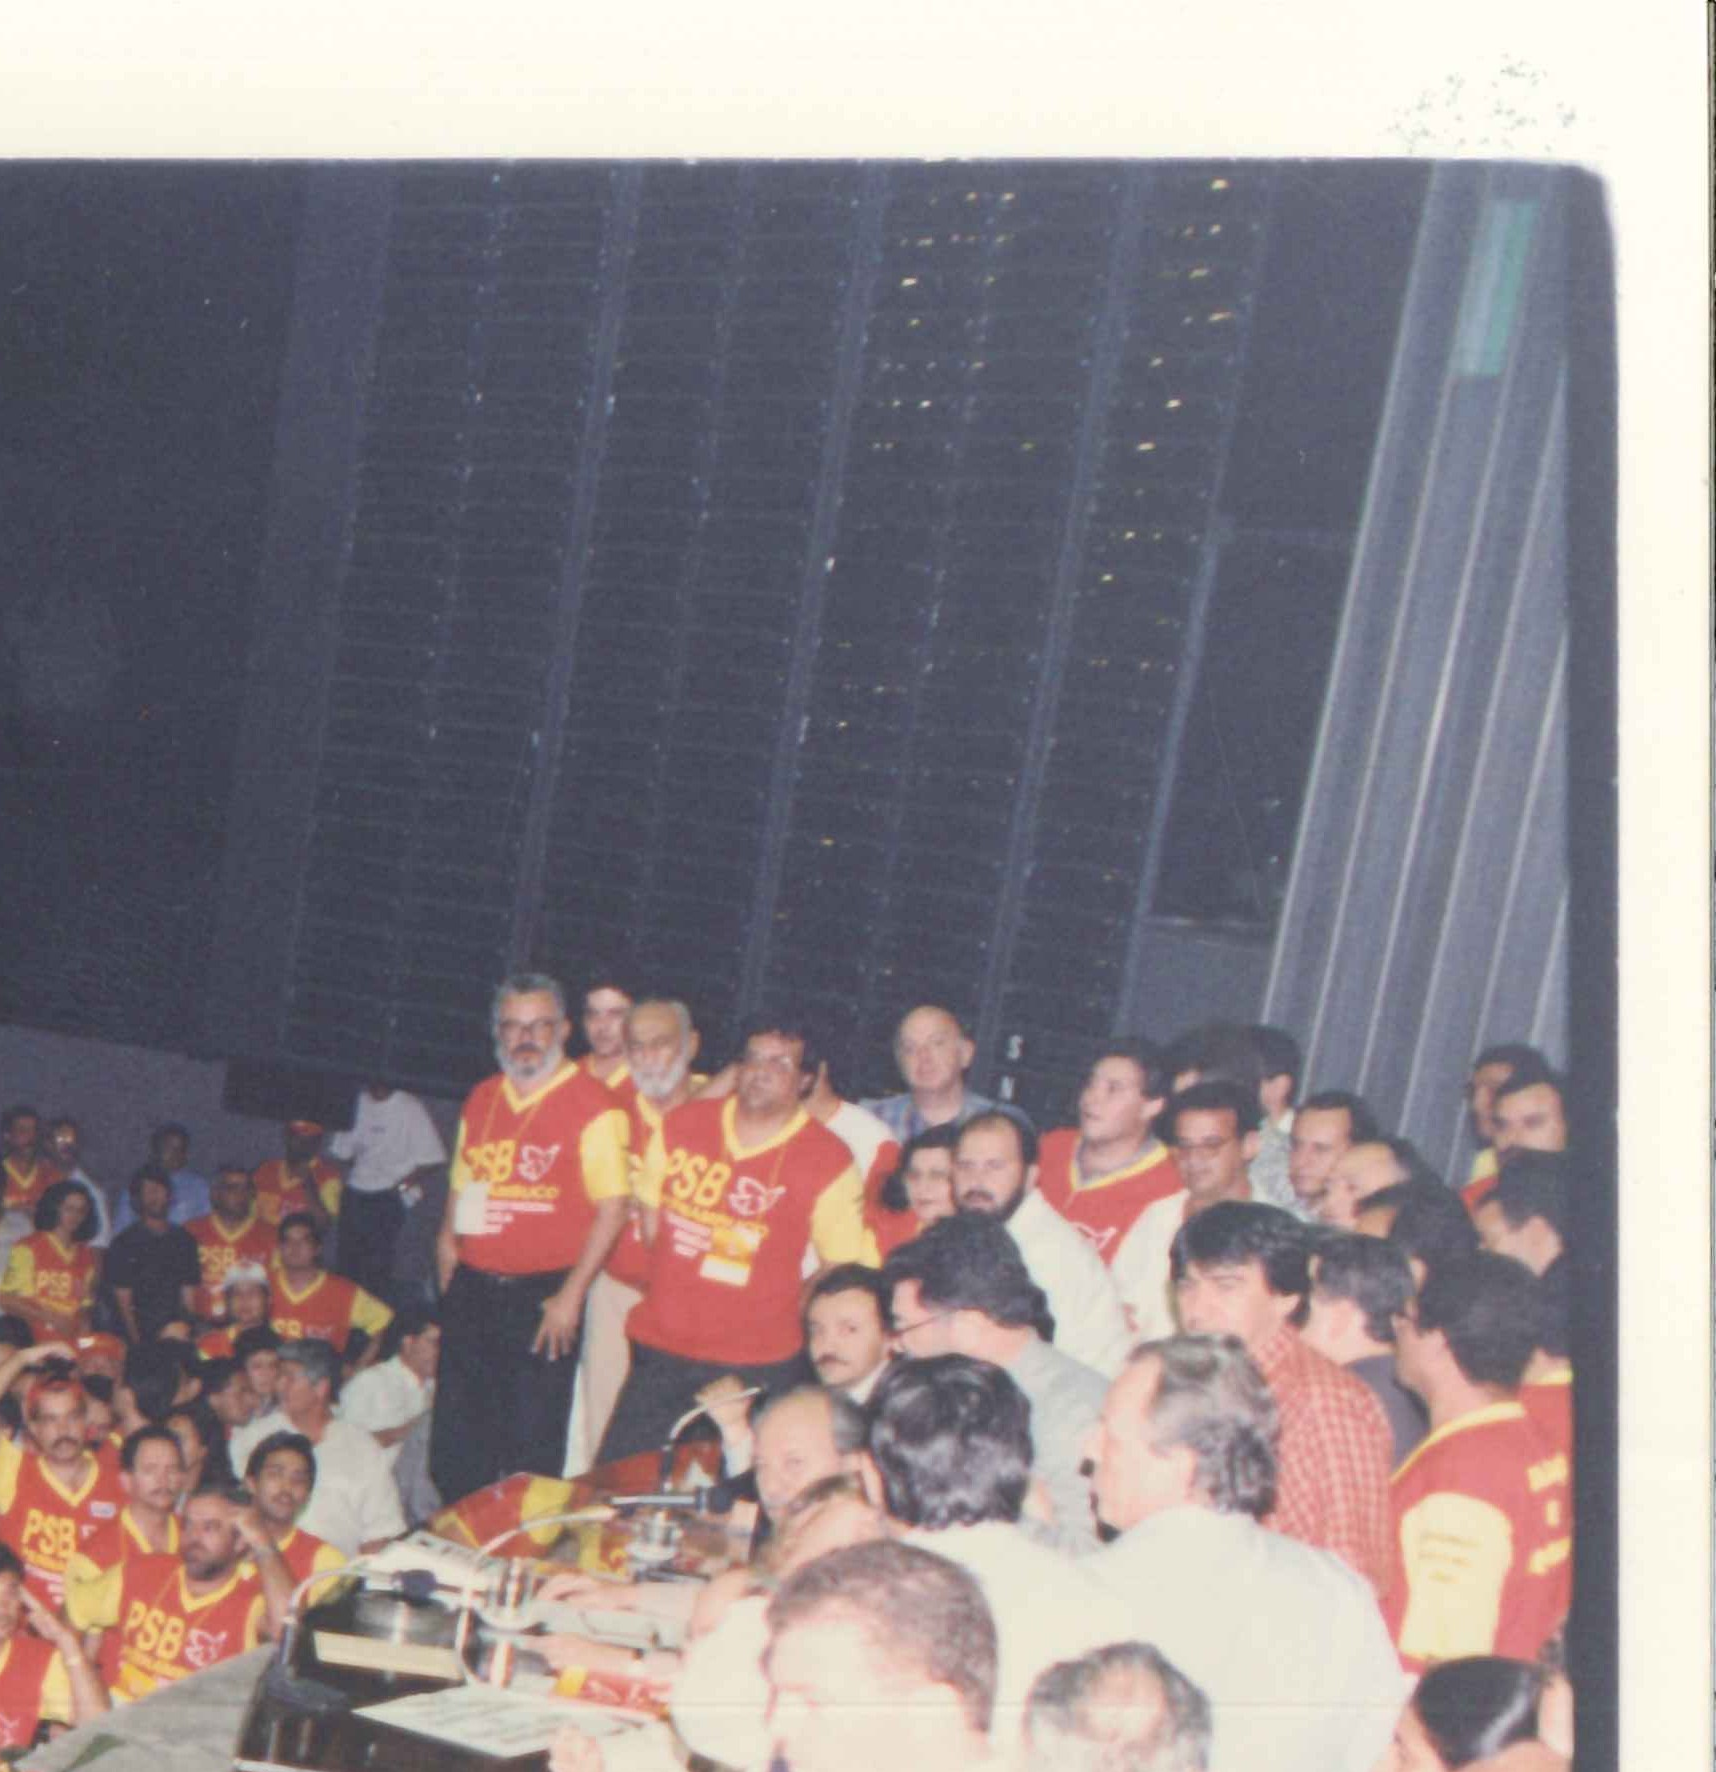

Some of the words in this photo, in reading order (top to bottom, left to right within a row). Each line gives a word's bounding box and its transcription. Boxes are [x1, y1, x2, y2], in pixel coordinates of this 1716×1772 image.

[1007, 1035, 1023, 1061] S
[466, 1140, 516, 1182] PSB
[664, 1147, 731, 1207] PSB
[35, 1271, 72, 1299] PSB
[21, 1509, 76, 1558] PSB
[123, 1601, 184, 1662] PSB
